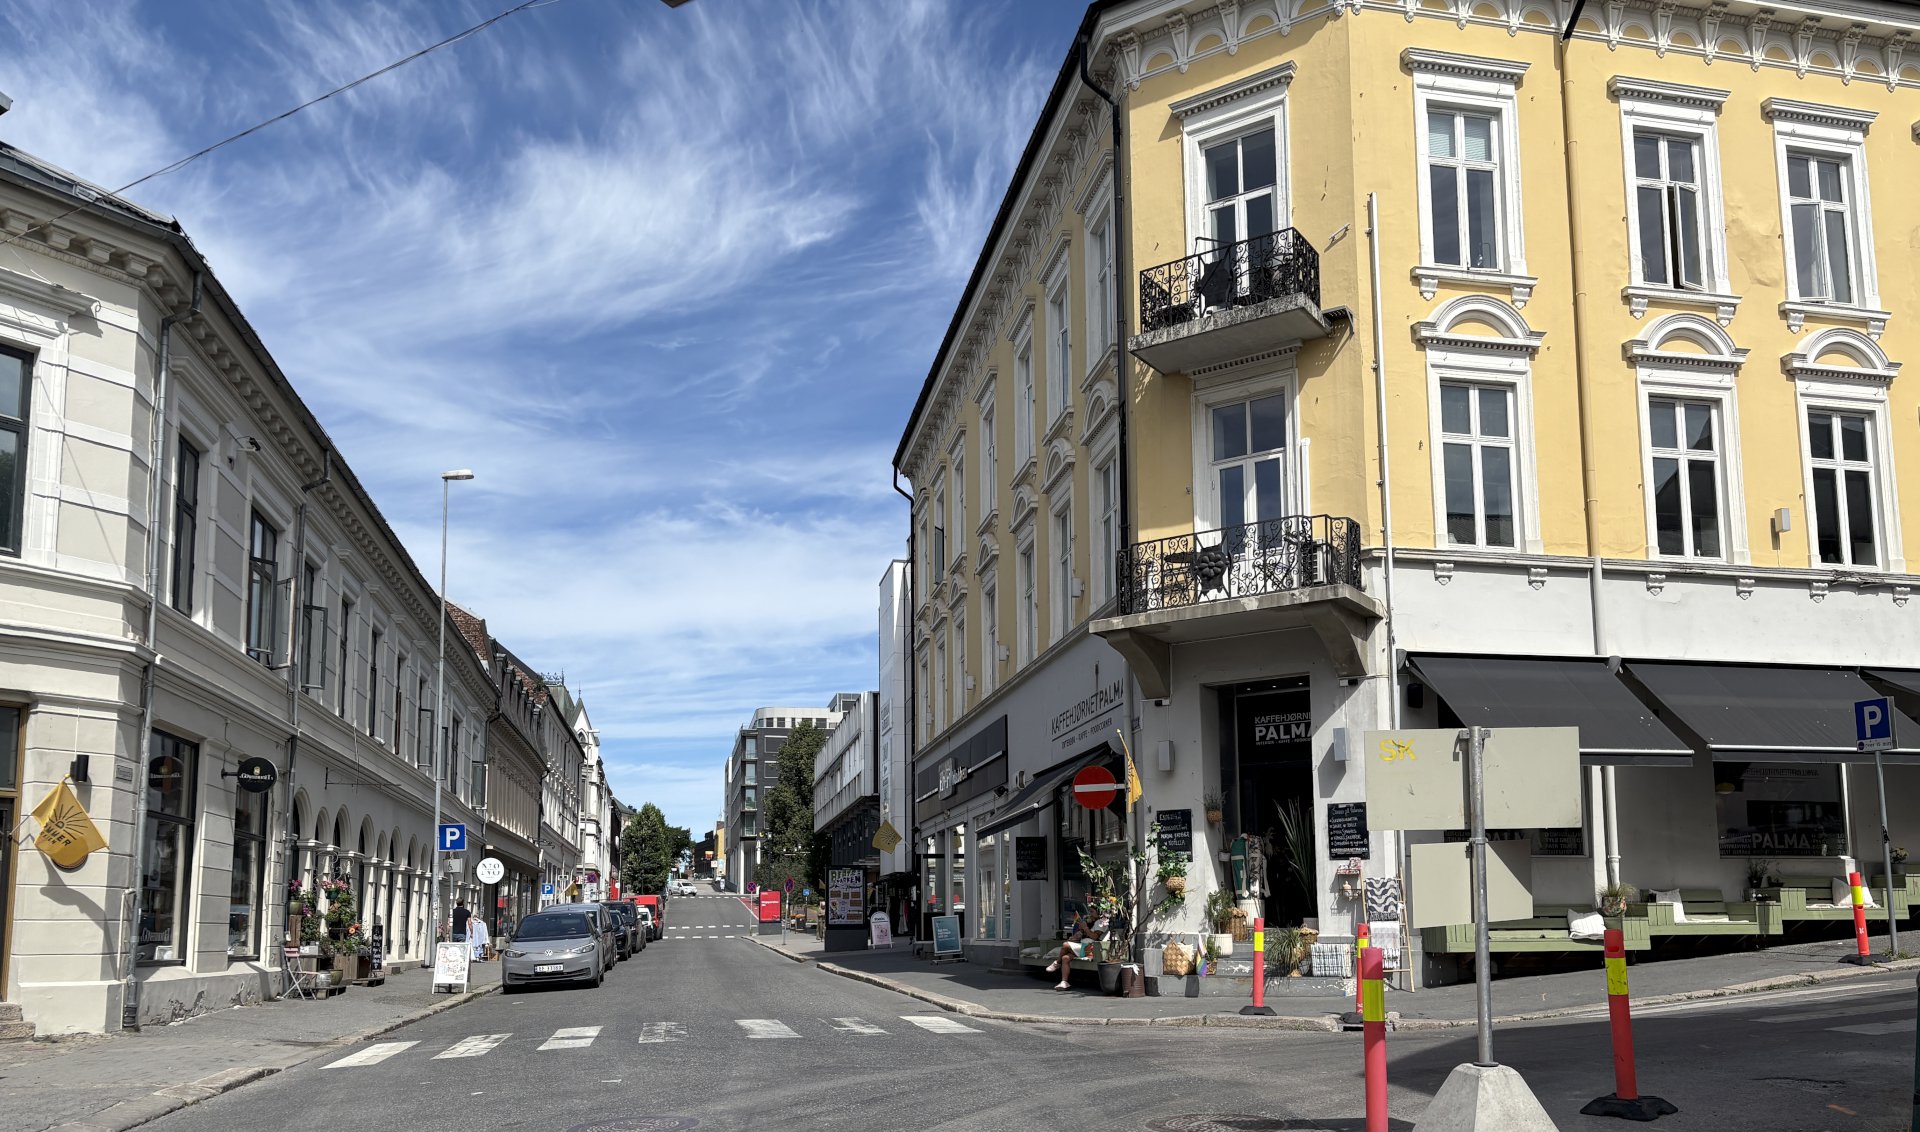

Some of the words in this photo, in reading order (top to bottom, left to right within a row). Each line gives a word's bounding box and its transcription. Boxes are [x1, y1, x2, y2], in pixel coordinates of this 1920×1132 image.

[1863, 705, 1882, 738] P
[1379, 738, 1417, 762] SK
[445, 827, 460, 848] P
[1751, 833, 1811, 849] PALMA
[544, 885, 551, 893] P
